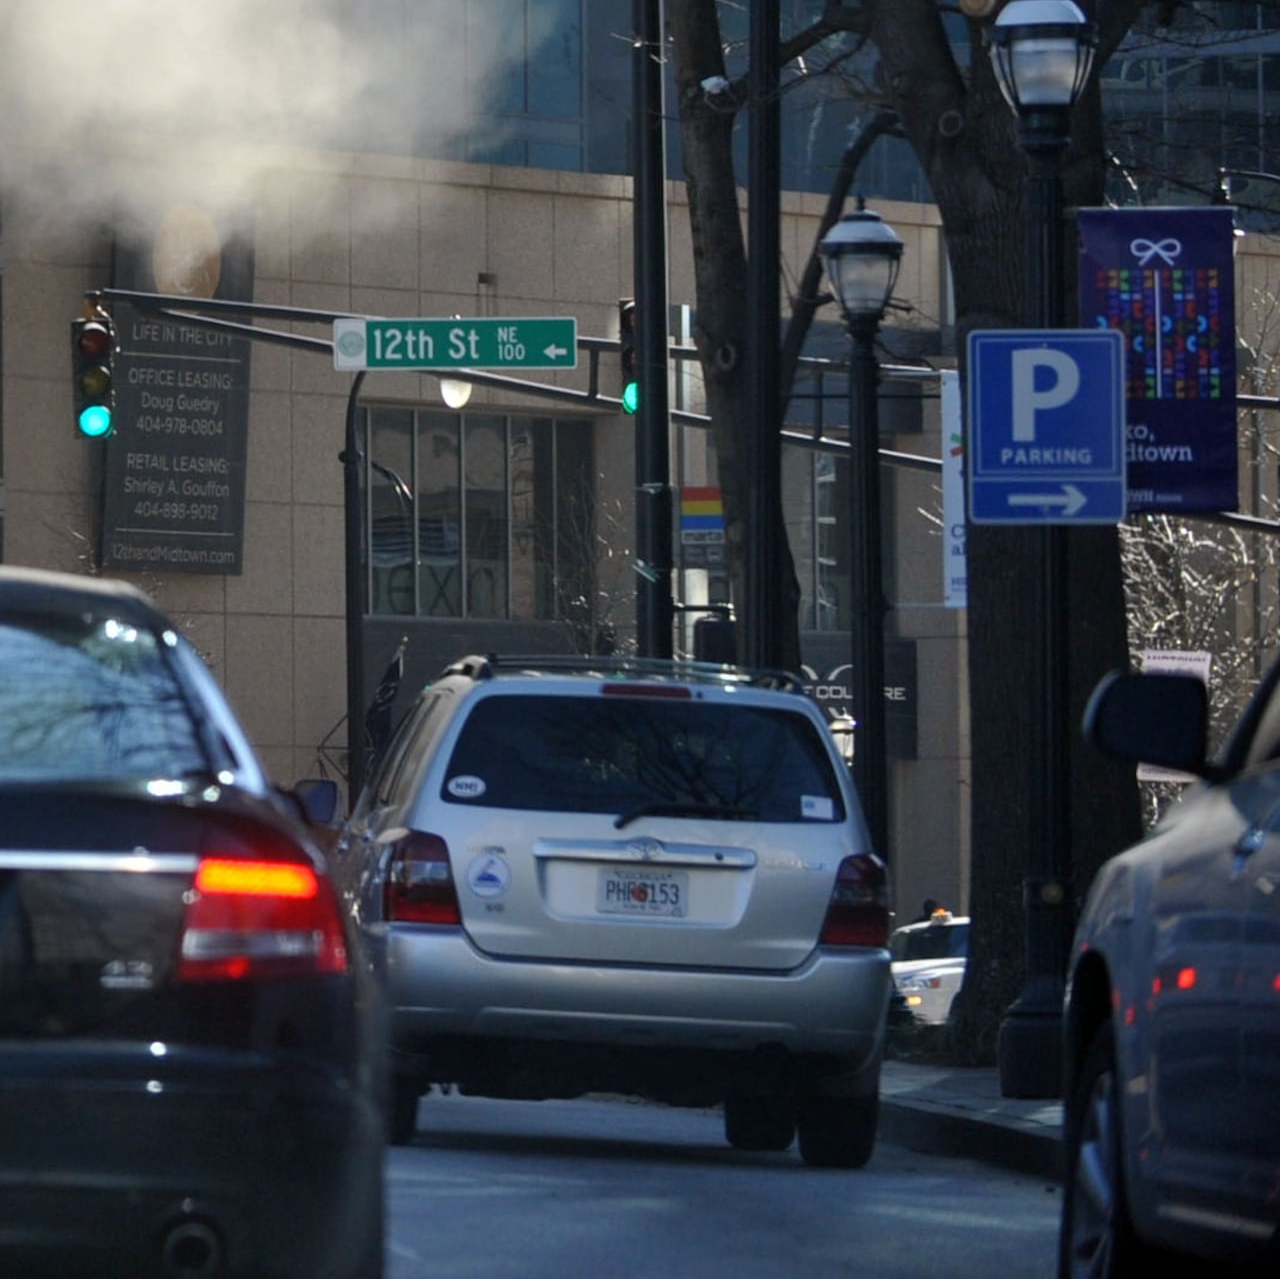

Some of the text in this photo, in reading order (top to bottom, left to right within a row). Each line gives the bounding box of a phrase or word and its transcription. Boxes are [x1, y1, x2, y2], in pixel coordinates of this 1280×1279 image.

[132, 324, 232, 347] LIFE IN THE CITY
[373, 328, 480, 360] 12th St
[497, 327, 518, 343] NE
[497, 344, 525, 361] 100
[128, 368, 234, 390] OFFICE LEASING:
[142, 392, 220, 416] Doug Guedry
[1012, 348, 1080, 442] P
[126, 453, 231, 474] RETAIL LEASING:
[1001, 448, 1092, 465] PARKING
[123, 477, 165, 497] Shirley
